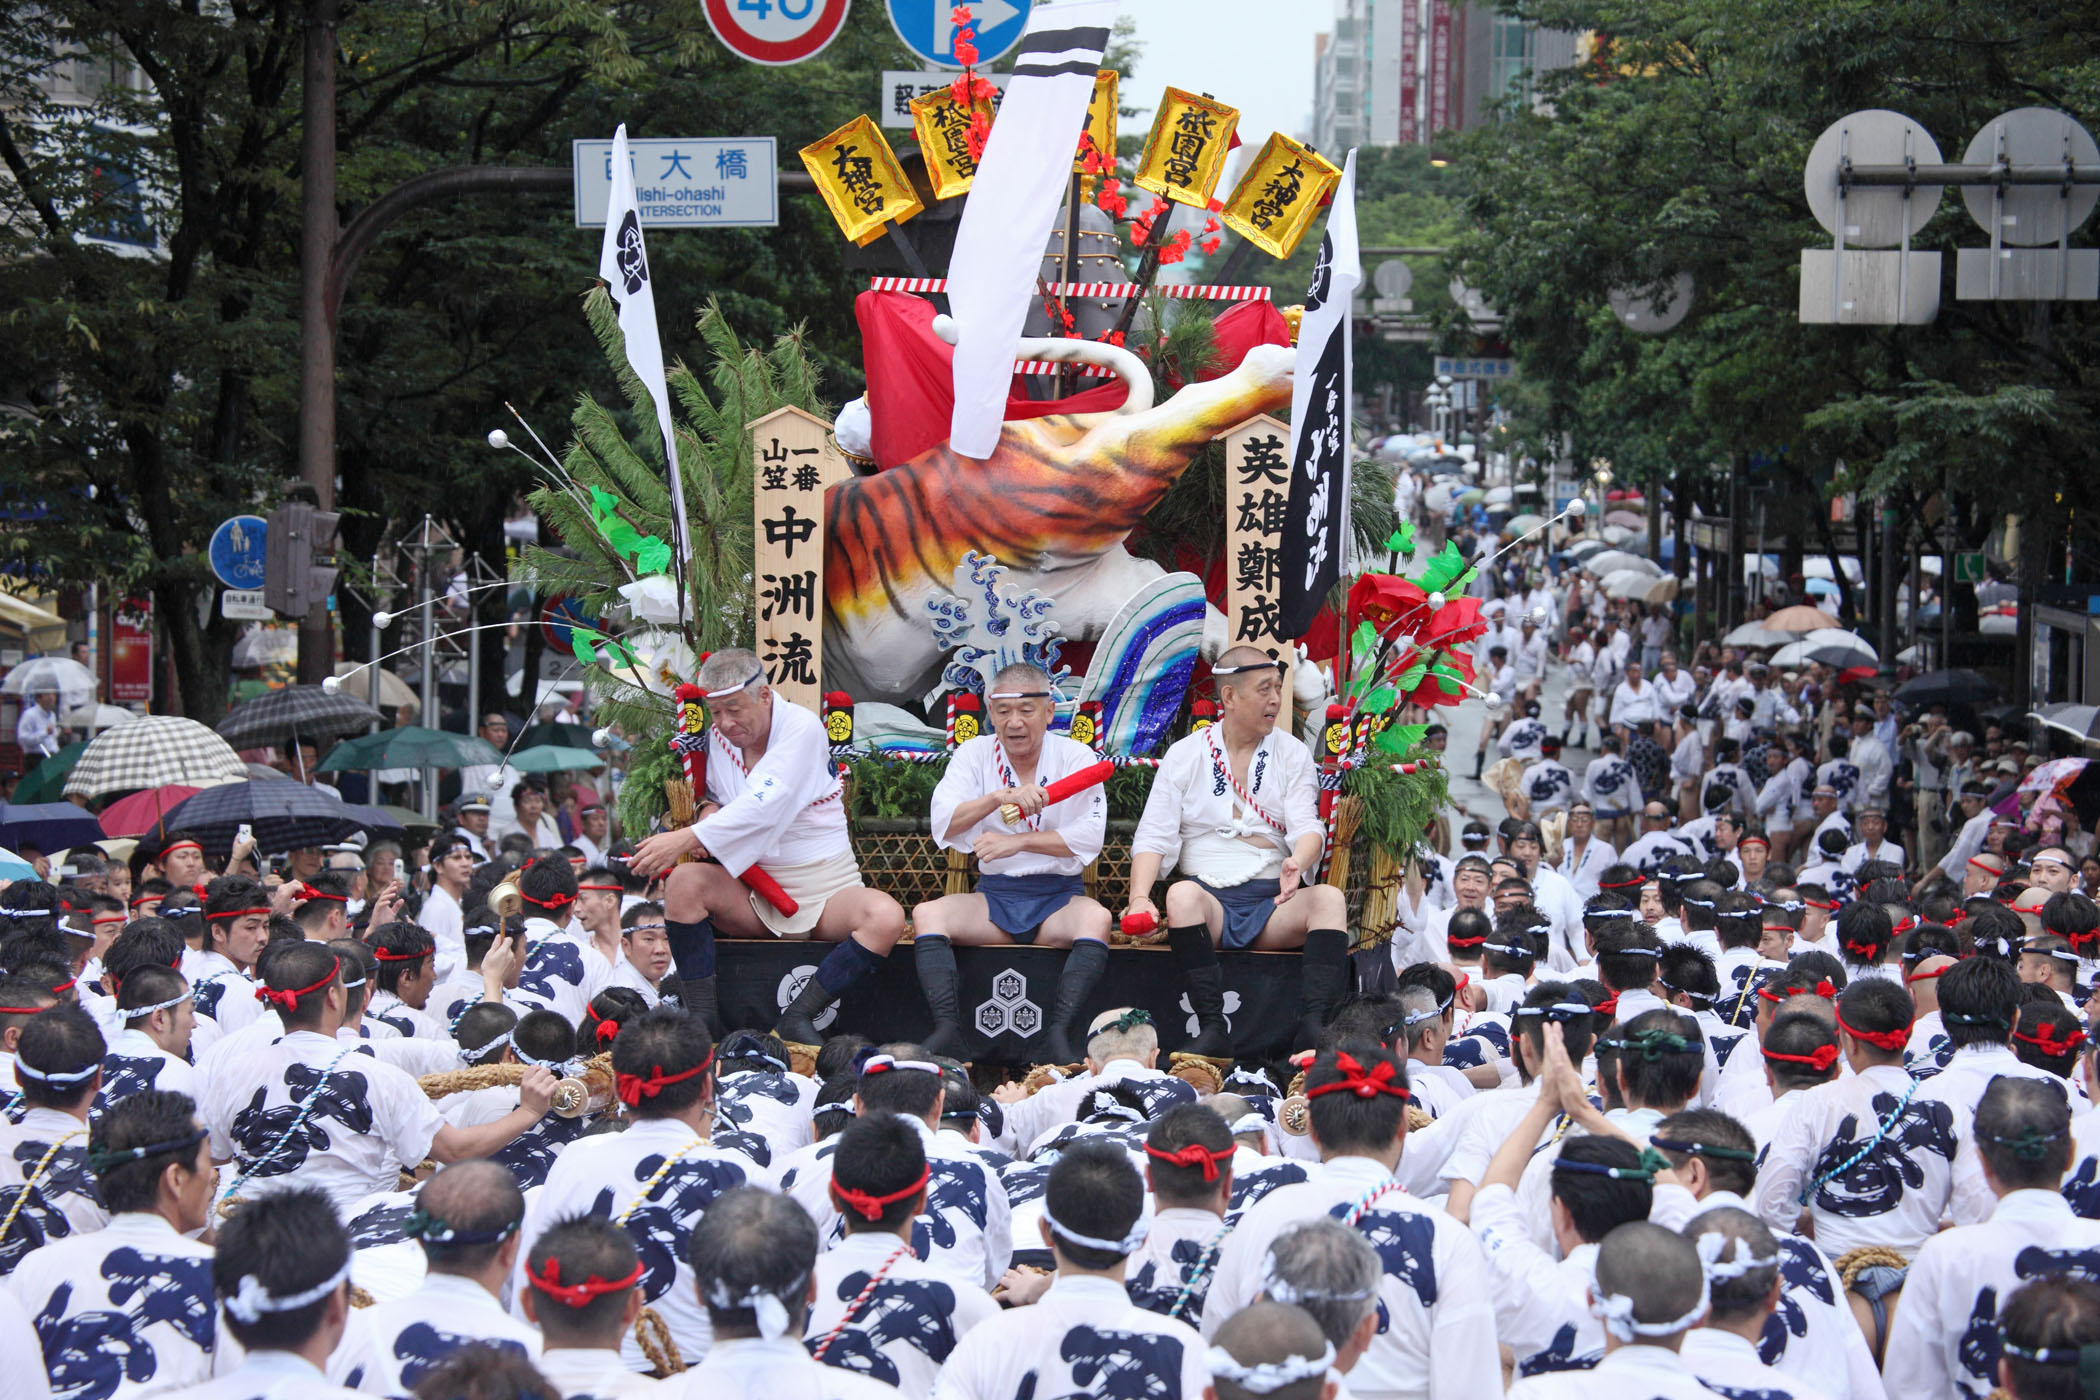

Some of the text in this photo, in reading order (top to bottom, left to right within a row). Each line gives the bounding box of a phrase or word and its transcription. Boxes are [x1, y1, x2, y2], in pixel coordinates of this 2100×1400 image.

[832, 145, 884, 215] 大神宮
[1164, 107, 1216, 188] 祇園宮
[637, 186, 725, 201] ishi-ohashi
[1251, 158, 1304, 231] 大神宮
[760, 505, 818, 685] 中洲流
[1234, 434, 1289, 687] 英雄鄭成
